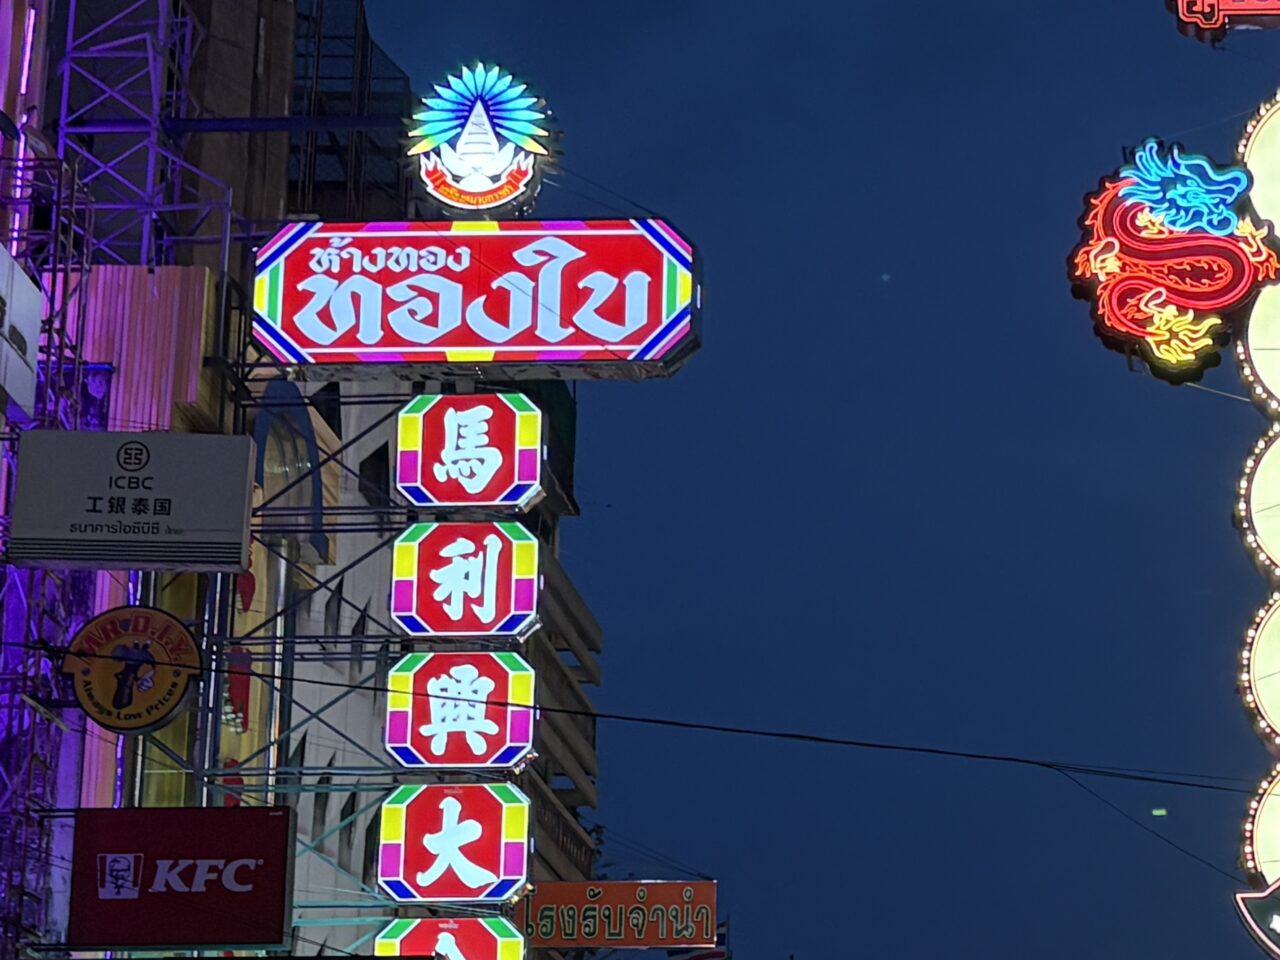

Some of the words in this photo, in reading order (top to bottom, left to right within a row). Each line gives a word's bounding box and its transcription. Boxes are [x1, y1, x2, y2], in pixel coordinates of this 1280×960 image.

[310, 236, 471, 274] ห้างทอง
[293, 236, 652, 346] ทองใบ
[109, 475, 154, 490] ICBC
[85, 496, 172, 516] 工银泰国
[69, 521, 160, 535] ธนาคารไอซีบีซี
[82, 679, 114, 717] Always
[114, 703, 144, 721] Low
[144, 681, 179, 715] Prices
[152, 859, 257, 893] KFC
[525, 887, 713, 941] โรงรับจำนำ
